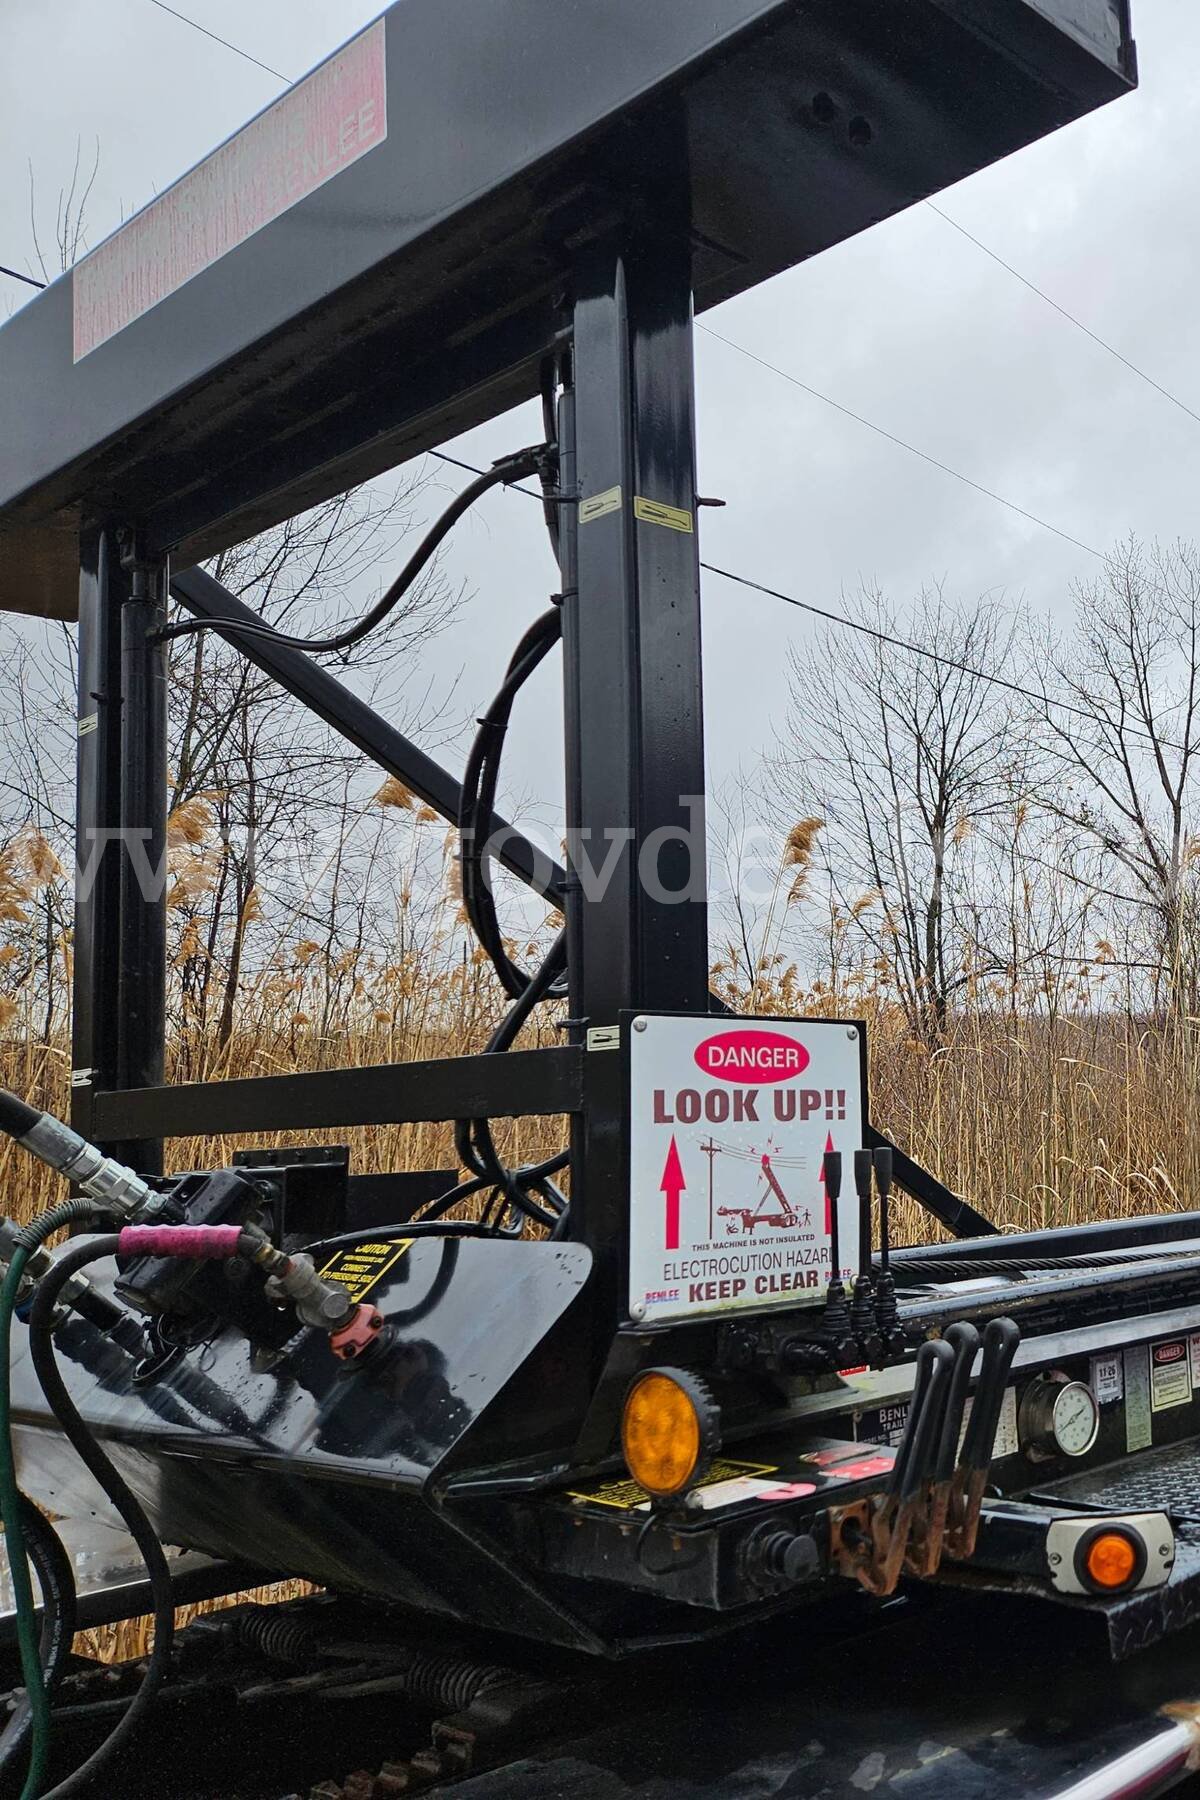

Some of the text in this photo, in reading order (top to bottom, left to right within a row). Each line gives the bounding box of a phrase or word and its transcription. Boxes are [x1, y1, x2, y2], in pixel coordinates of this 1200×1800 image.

[708, 1046, 799, 1069] DANGER
[653, 1089, 846, 1124] LOOK UP!!
[712, 1240, 748, 1250] MACHINE
[750, 1239, 757, 1247] IS
[758, 1238, 774, 1246] NOT
[776, 1234, 815, 1244] INSULATED
[663, 1252, 782, 1281] ELECTROCUTION
[689, 1270, 818, 1303] KEEP CLEAR
[1159, 1346, 1180, 1360] DANGER
